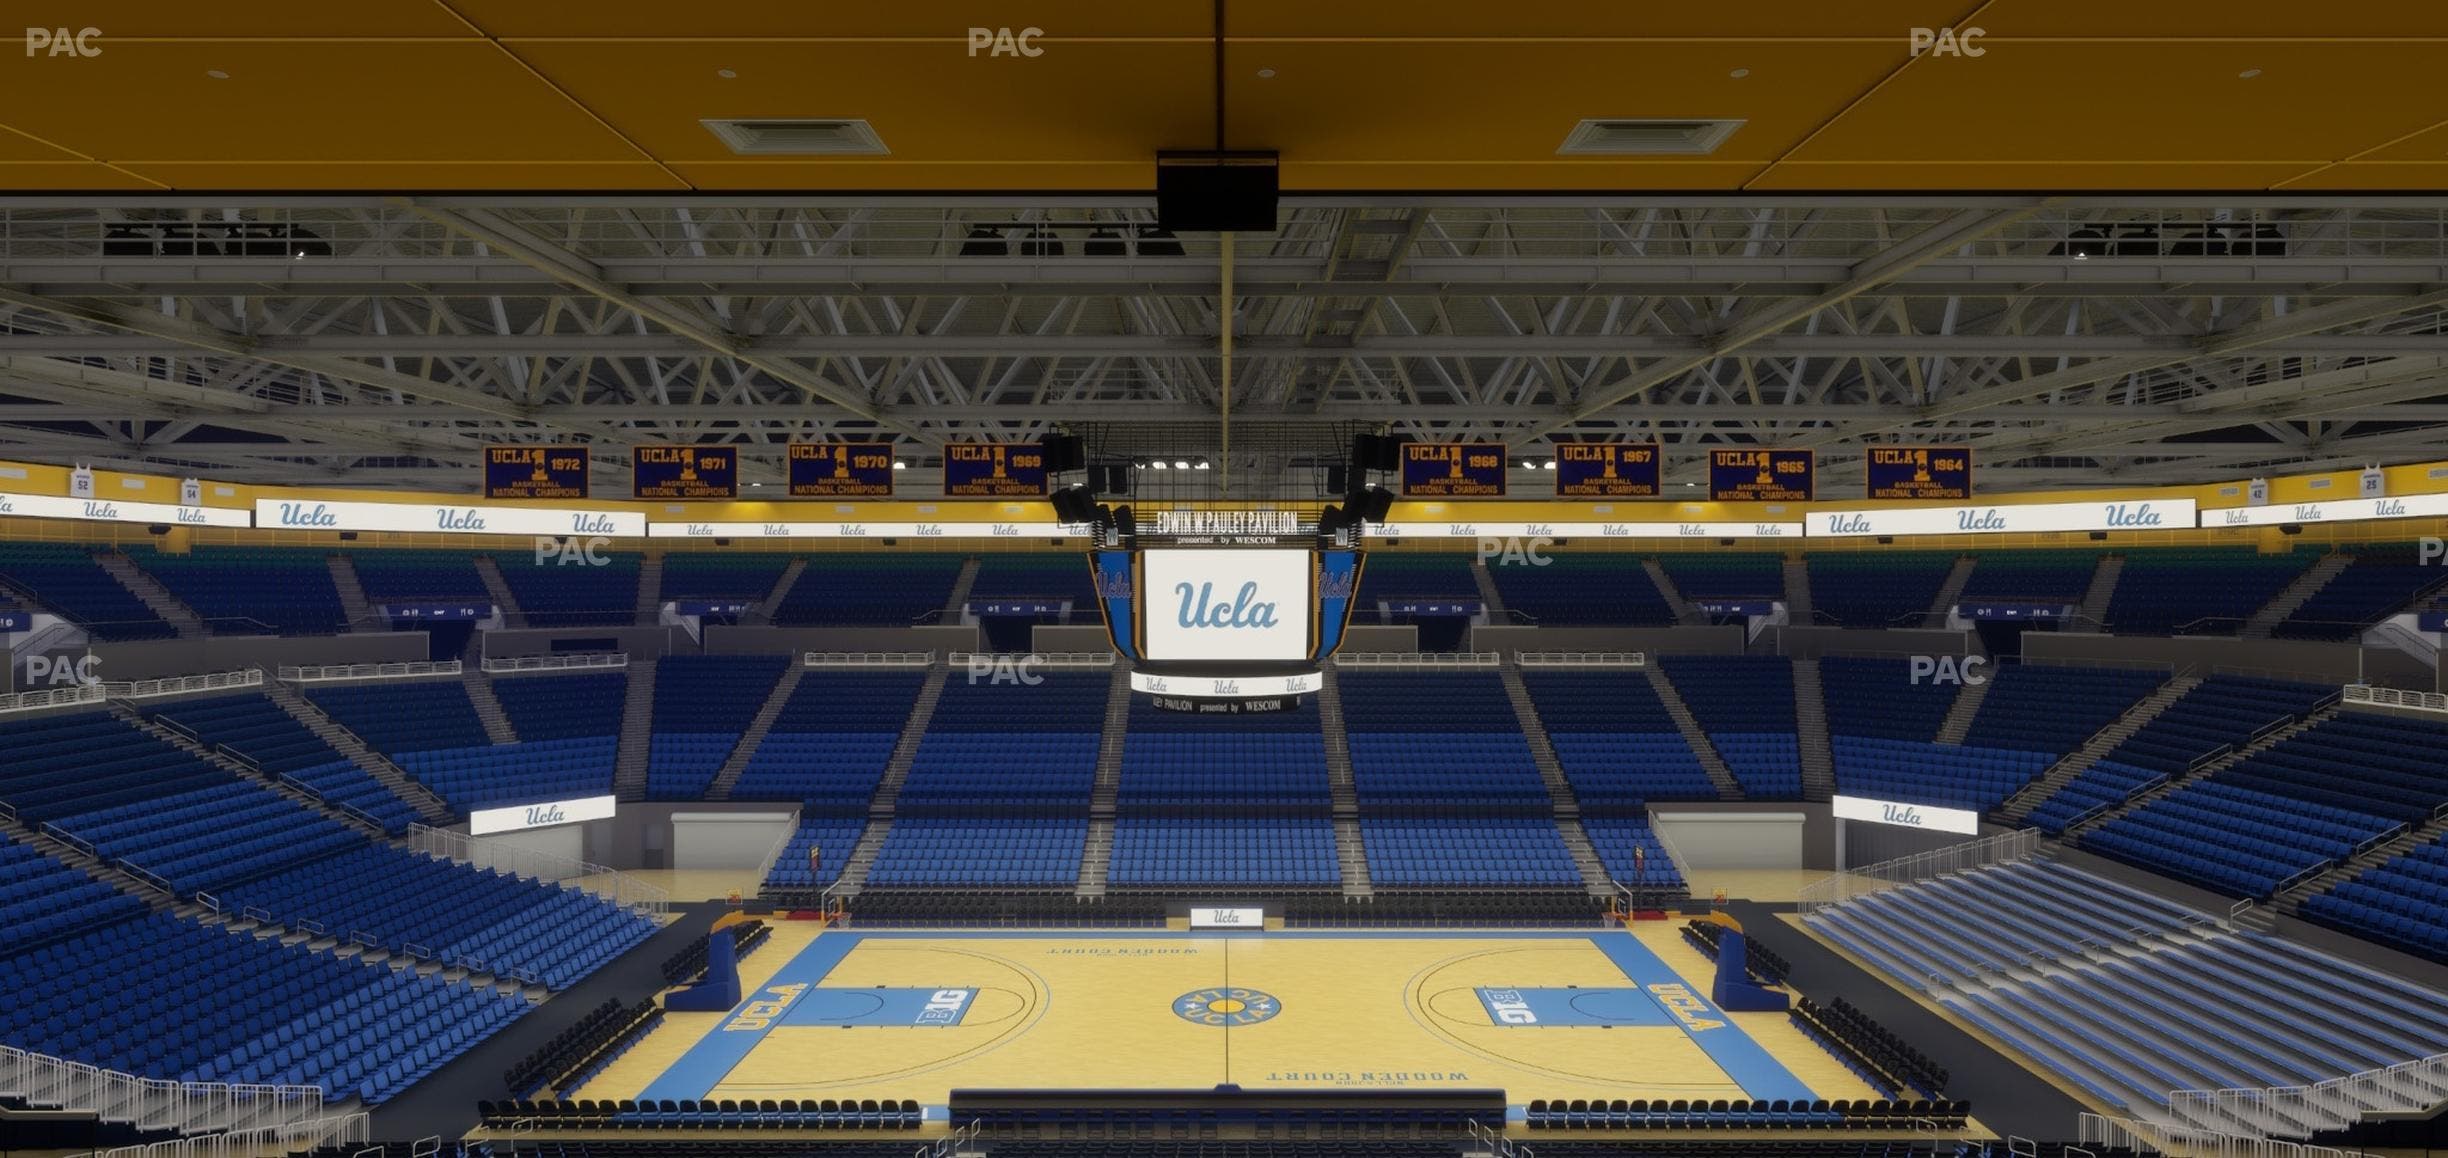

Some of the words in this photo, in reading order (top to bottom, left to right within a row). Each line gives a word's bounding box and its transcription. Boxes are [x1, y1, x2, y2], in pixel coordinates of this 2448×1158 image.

[492, 450, 531, 463] UCLA
[531, 450, 548, 480] 1
[551, 458, 580, 470] 1972
[641, 450, 680, 463] UCLA
[680, 449, 697, 481] 1
[700, 458, 726, 470] 1971
[791, 447, 827, 460] UCLA
[834, 446, 849, 478] 1
[853, 455, 887, 468] 1970
[951, 446, 991, 460] UCLA
[993, 446, 1007, 477] 1
[1012, 455, 1041, 467] 1969
[1409, 447, 1449, 460] UCLA
[1449, 446, 1463, 478] 1
[1564, 447, 1603, 460] UCLA
[1603, 446, 1617, 478] 1
[1623, 451, 1651, 462] 1967
[1716, 453, 1755, 466] UCLA
[1755, 452, 1773, 484] 1
[1776, 461, 1805, 473] 1965
[1874, 451, 1913, 464] UCLA
[1913, 450, 1931, 481] 1
[1933, 459, 1964, 471] 1964
[493, 488, 529, 497] NATIONAL
[535, 488, 580, 497] CHAMPIONS
[641, 488, 679, 497] NATIONAL
[683, 488, 729, 497] CHAMPIONS
[795, 485, 836, 494] NATIONAL
[838, 485, 888, 494] CHAMPIONS
[952, 485, 989, 494] NATIONAL
[994, 485, 1040, 494] CHAMPIONS
[1410, 485, 1447, 494] NATIONAL
[1452, 485, 1498, 494] CHAMPIONS
[1564, 485, 1600, 494] NATIONAL
[1607, 485, 1652, 494] CHAMPIONS
[1717, 491, 1754, 499] NATIONAL
[1760, 491, 1805, 499] CHAMPIONS
[1875, 489, 1912, 497] NATIONAL
[1918, 489, 1962, 497] CHAMPIONS
[84, 501, 118, 518] Ucla
[280, 503, 337, 526] Ucla
[2105, 503, 2162, 526] Ucla
[2295, 505, 2321, 520] Ucla
[2375, 499, 2406, 516] Ucla
[177, 508, 206, 523] Ucla
[437, 508, 486, 530] Ucla
[1157, 511, 1191, 533] EDWIN
[1206, 511, 1246, 533] PAULEY
[1248, 511, 1298, 533] PAVILION
[1957, 508, 2005, 530] Ucla
[2225, 510, 2248, 524] Ucla
[572, 513, 615, 534] Ucla
[687, 525, 713, 536] Ucla
[763, 525, 789, 536] Ucla
[840, 525, 866, 536] Ucla
[916, 525, 942, 536] Ucla
[992, 525, 1018, 536] Ucla
[1450, 525, 1476, 536] Ucla
[1526, 525, 1552, 536] Ucla
[1603, 525, 1629, 536] Ucla
[1679, 525, 1705, 536] Ucla
[1755, 525, 1782, 536] Ucla
[1828, 514, 1872, 533] Ucla
[1177, 537, 1214, 545] presented
[1221, 537, 1231, 545] by
[1175, 581, 1279, 629] Ucla
[1146, 677, 1167, 692] Ucla
[1214, 680, 1239, 694] Ucla
[1285, 677, 1307, 691] Ucla
[1164, 699, 1193, 711] PAVILION
[1200, 703, 1227, 712] presented
[1231, 703, 1239, 713] by
[1245, 700, 1280, 711] WESCOM
[526, 804, 565, 825] Ucla
[1883, 804, 1922, 825] Ucla
[1214, 910, 1239, 923] Ucla
[723, 983, 808, 1032] UCLA
[1647, 983, 1726, 1032] UCLA
[1265, 1072, 1351, 1081] COURT
[1362, 1072, 1469, 1081] WOODEN
